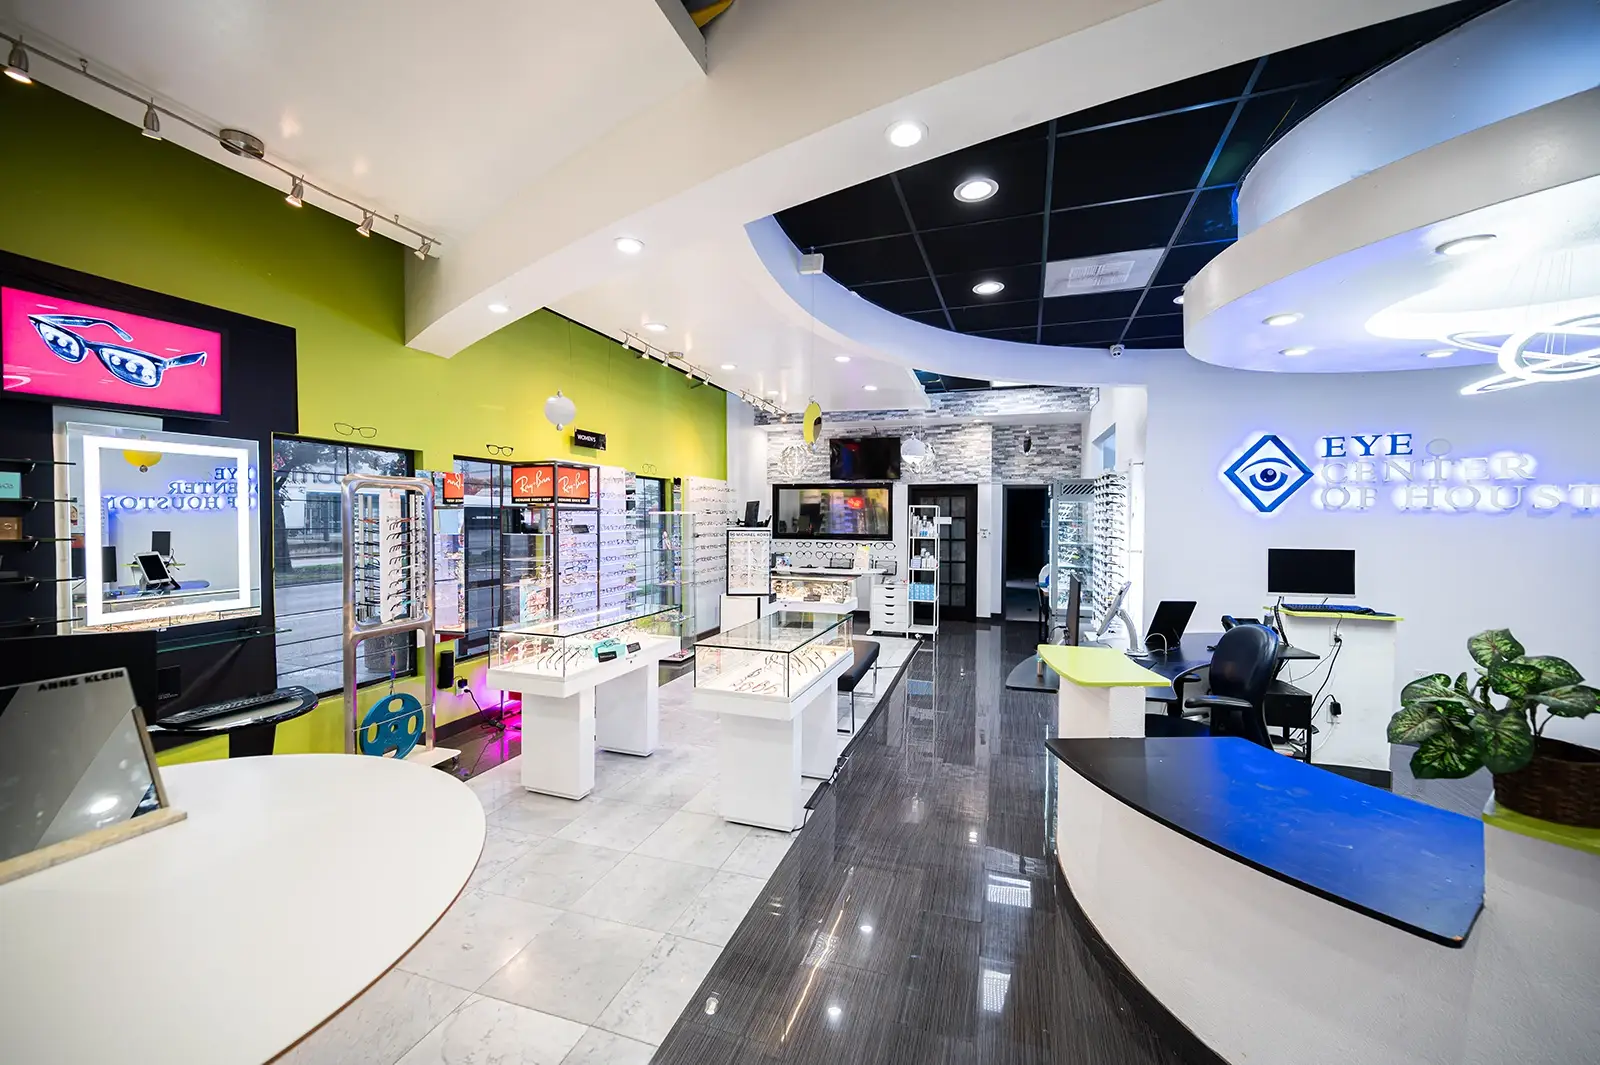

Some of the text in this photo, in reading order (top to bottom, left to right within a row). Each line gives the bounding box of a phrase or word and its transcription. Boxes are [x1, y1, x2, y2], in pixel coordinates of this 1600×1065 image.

[1321, 433, 1413, 458] EYE
[515, 470, 551, 494] Ray-Ban
[558, 472, 587, 493] Ray-Ban
[1321, 456, 1536, 485] CENTER
[1320, 483, 1600, 511] OF HOUST
[38, 670, 125, 692] ANNE KLEIN
